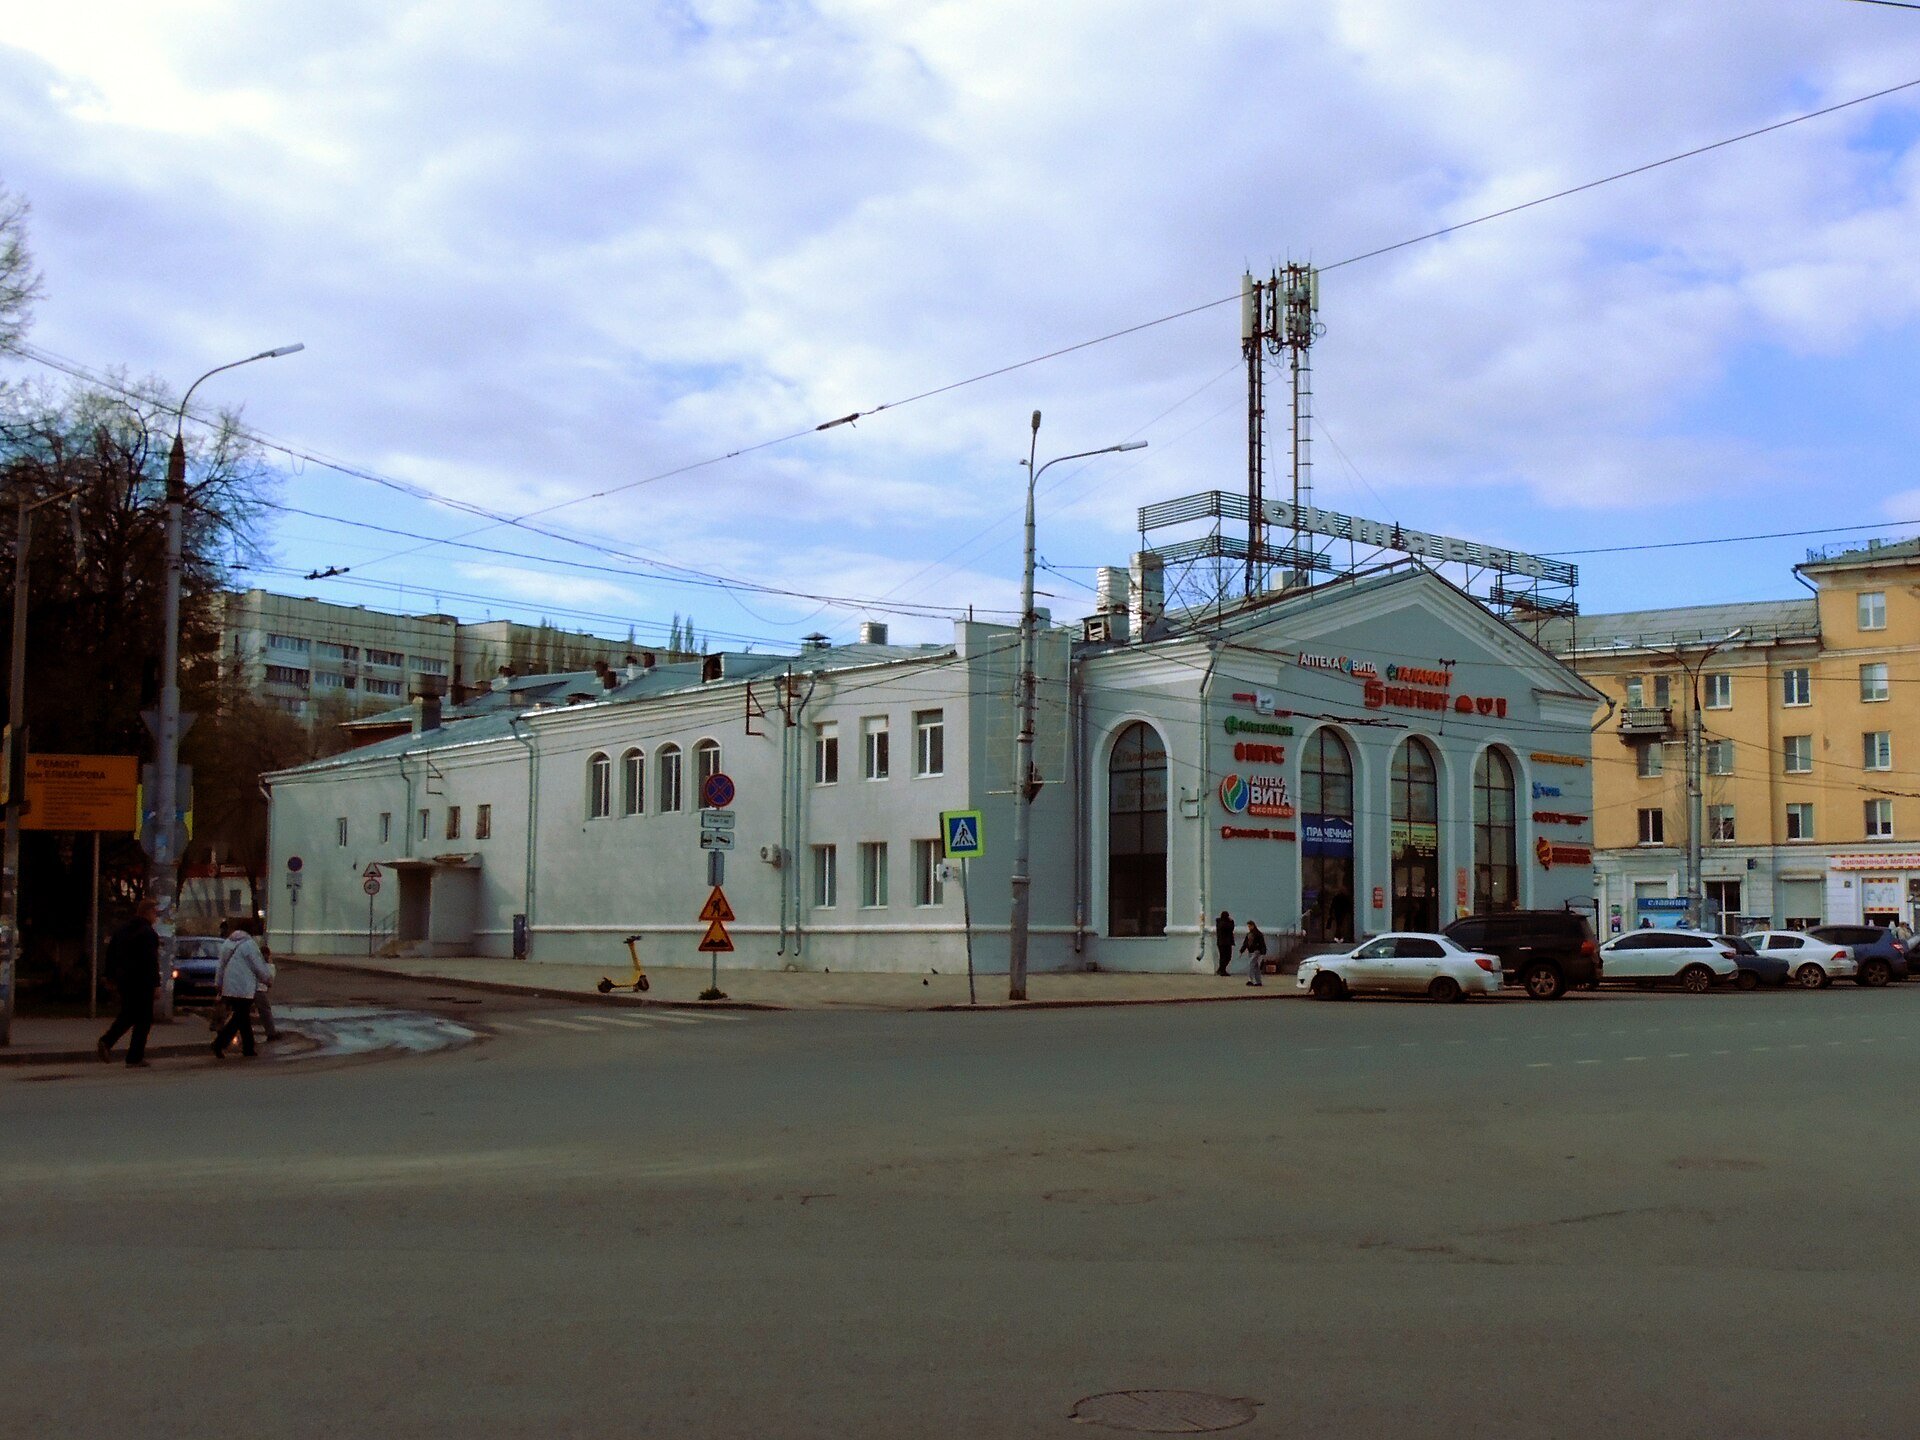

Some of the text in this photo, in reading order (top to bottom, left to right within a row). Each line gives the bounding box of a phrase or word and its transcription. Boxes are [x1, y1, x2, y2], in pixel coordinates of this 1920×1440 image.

[1298, 652, 1340, 669] АПТЕКА
[1352, 660, 1377, 674] ВИТА
[1250, 775, 1287, 788] АПТЕКА
[1250, 785, 1293, 807] ВИТА
